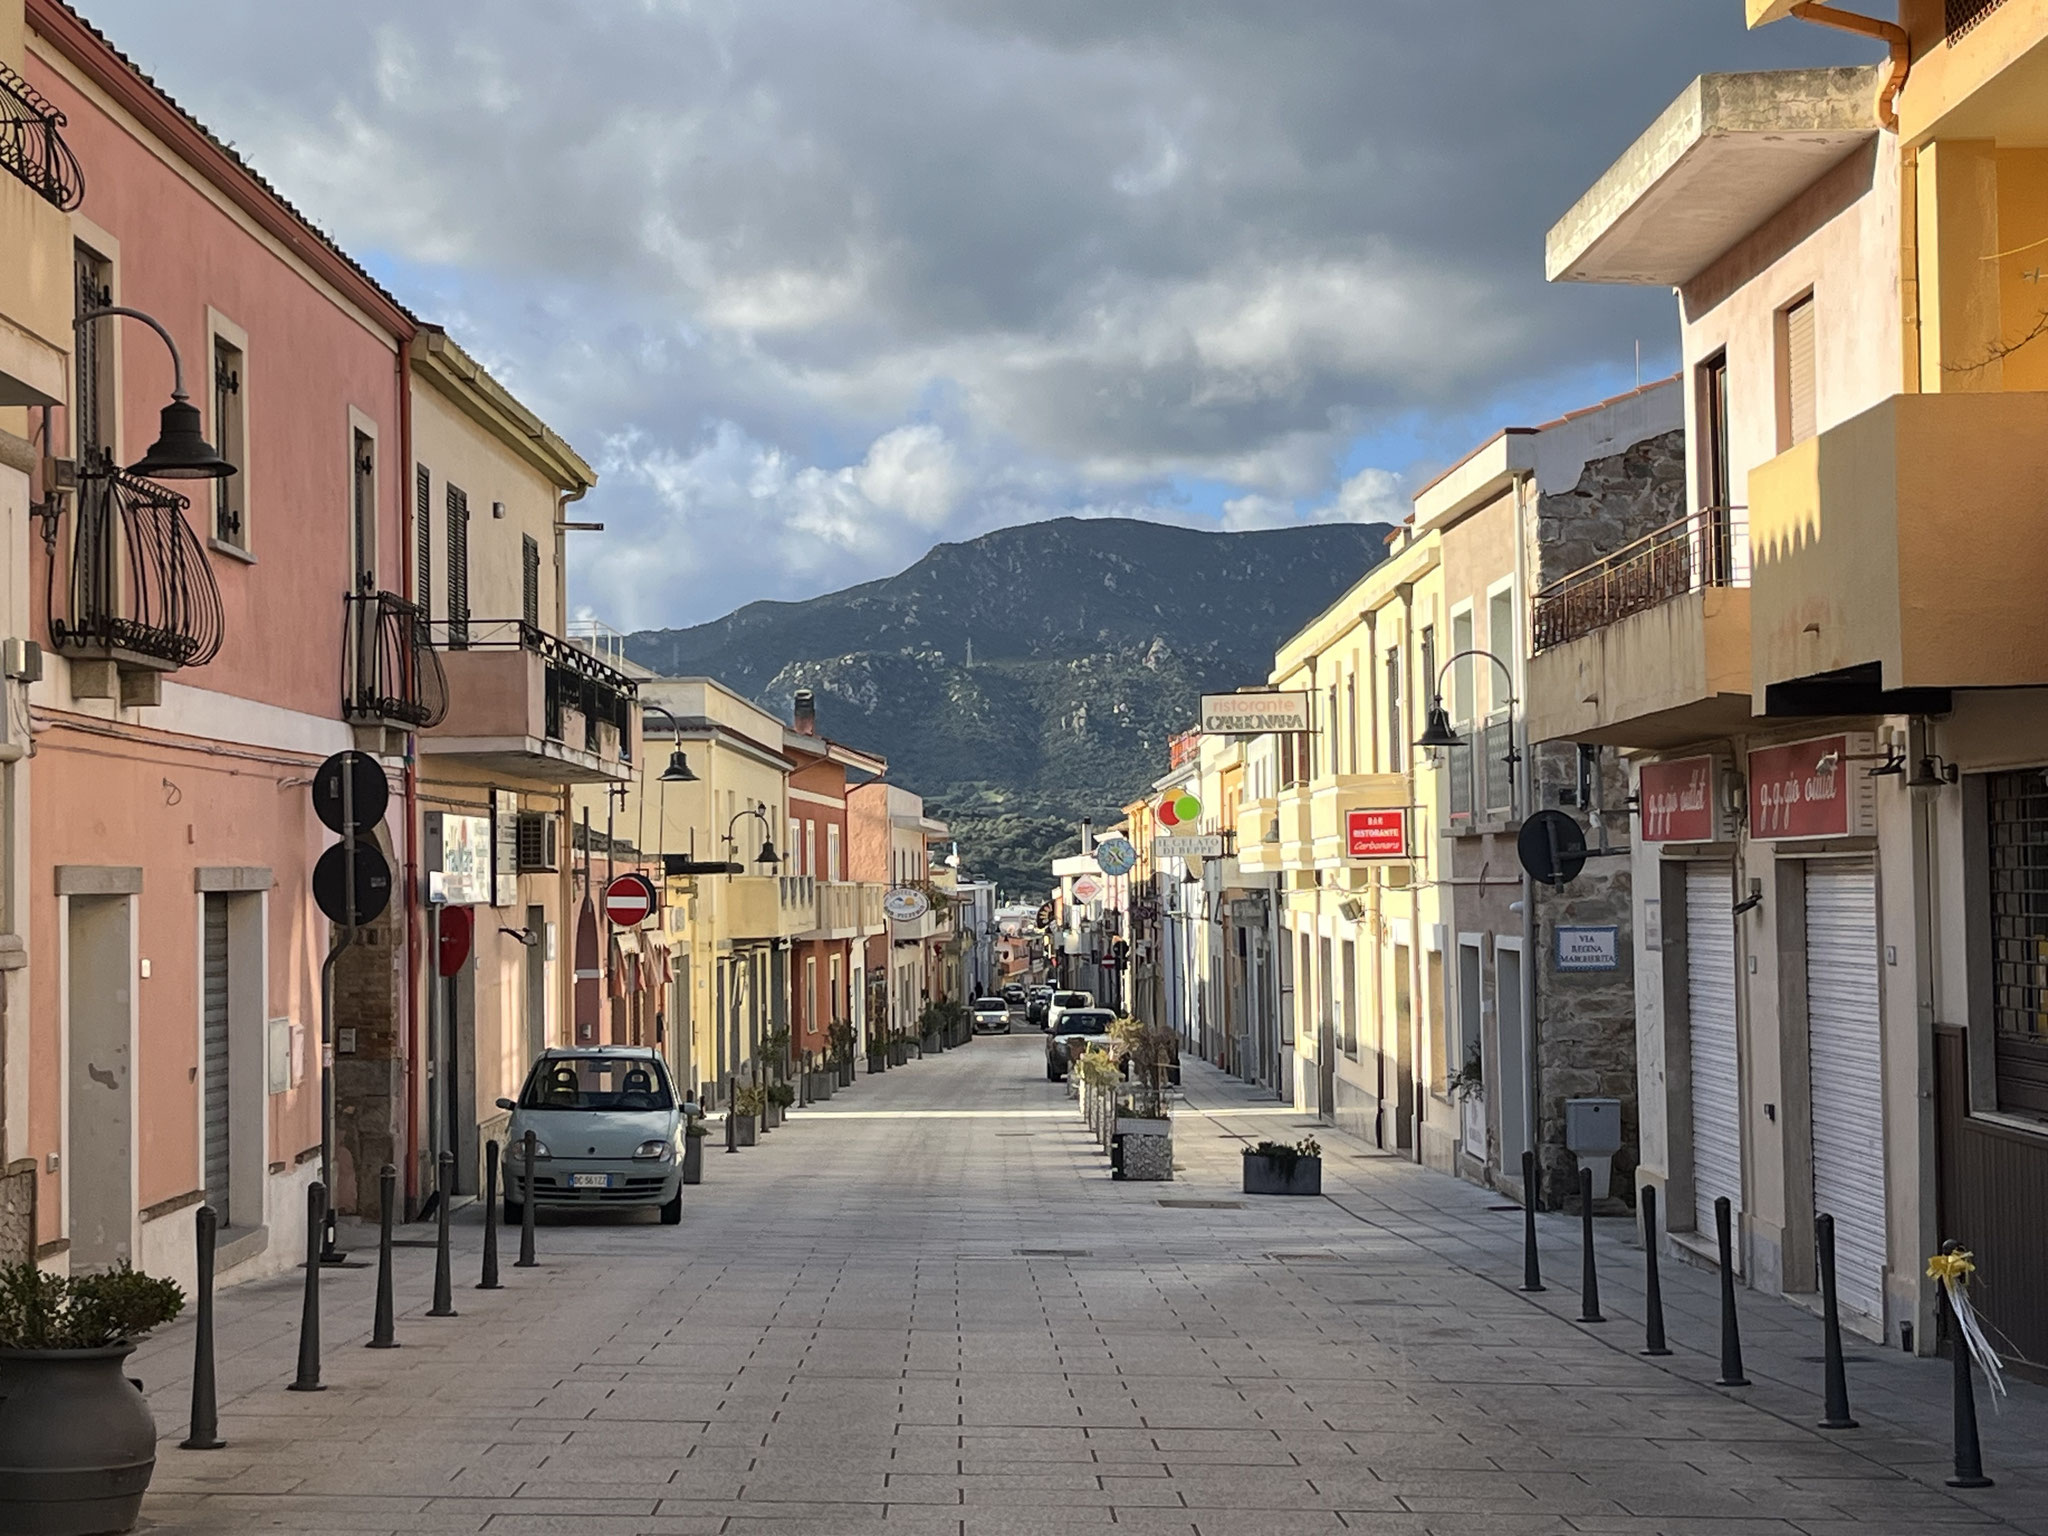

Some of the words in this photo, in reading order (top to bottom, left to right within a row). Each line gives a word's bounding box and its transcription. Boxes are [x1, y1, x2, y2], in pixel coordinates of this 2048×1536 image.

[1213, 699, 1296, 713] ristorante
[1205, 714, 1304, 731] CARBONARA
[1367, 816, 1384, 826] BAR
[1352, 828, 1400, 838] RISTORANTE
[1158, 839, 1169, 847] IL
[1172, 837, 1219, 847] GELATO
[1163, 847, 1175, 855] DI
[1179, 846, 1215, 855] BEPPE
[1579, 935, 1595, 943] VIA
[1571, 945, 1603, 953] REGINA
[1560, 954, 1616, 963] MARGHERITA
